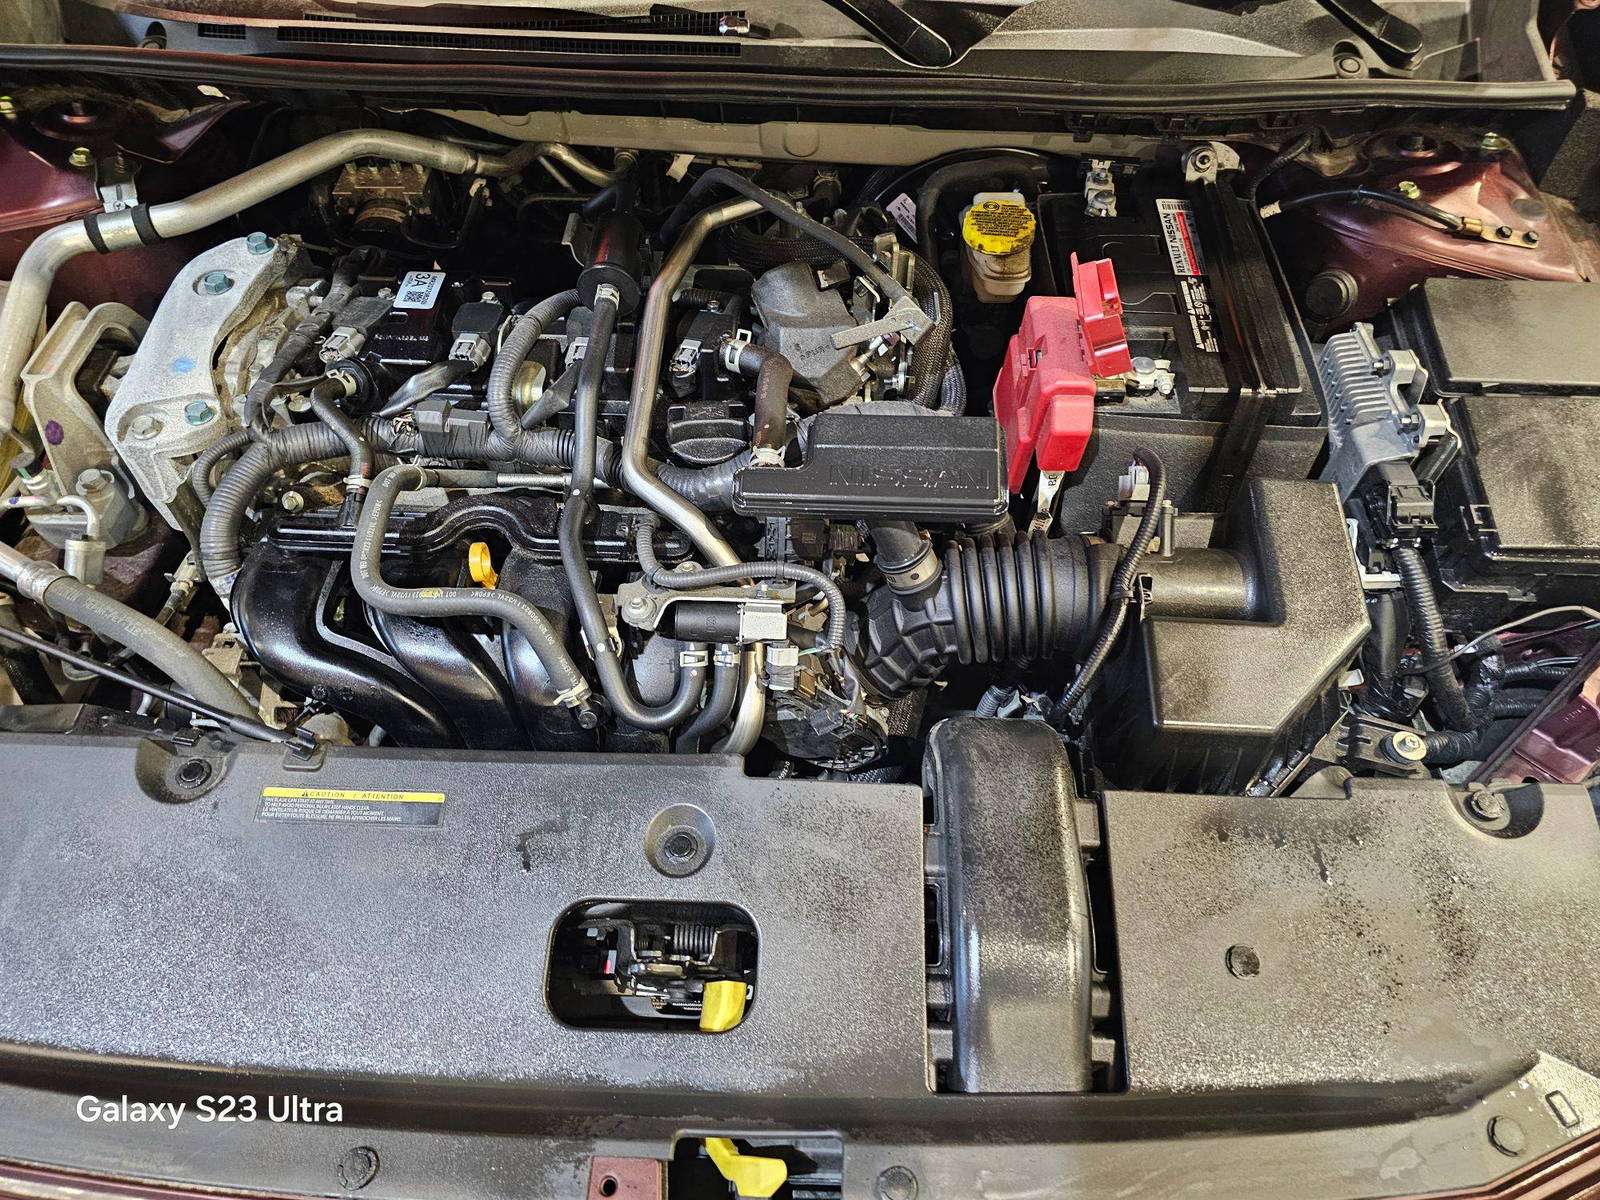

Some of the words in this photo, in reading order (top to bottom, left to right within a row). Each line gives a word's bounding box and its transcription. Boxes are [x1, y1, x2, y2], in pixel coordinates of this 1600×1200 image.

[1162, 212, 1178, 244] NISSAN
[1172, 245, 1186, 274] RENAULT
[412, 274, 430, 287] 3A
[830, 464, 990, 489] NISSAN
